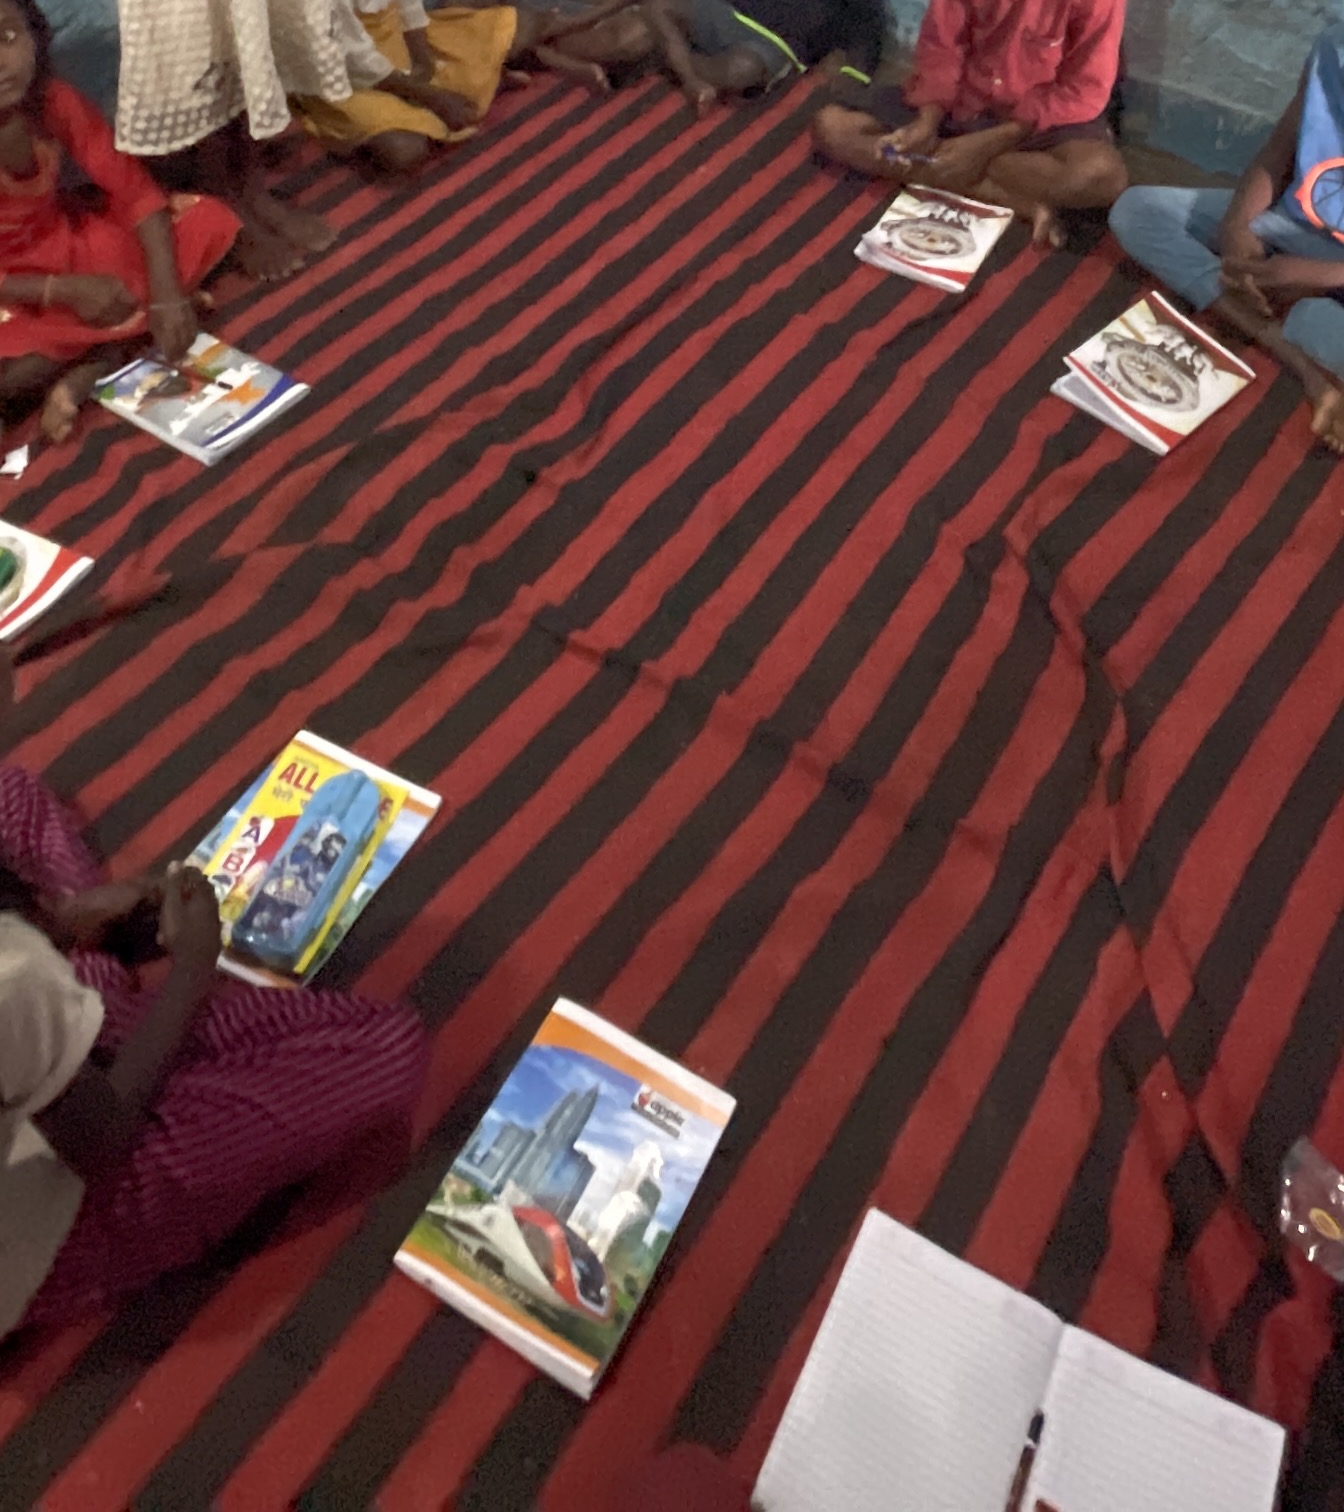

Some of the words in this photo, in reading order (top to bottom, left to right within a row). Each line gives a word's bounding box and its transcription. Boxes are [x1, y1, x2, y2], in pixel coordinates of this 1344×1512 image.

[278, 762, 319, 794] ALL
[241, 825, 261, 843] A
[222, 853, 245, 873] B
